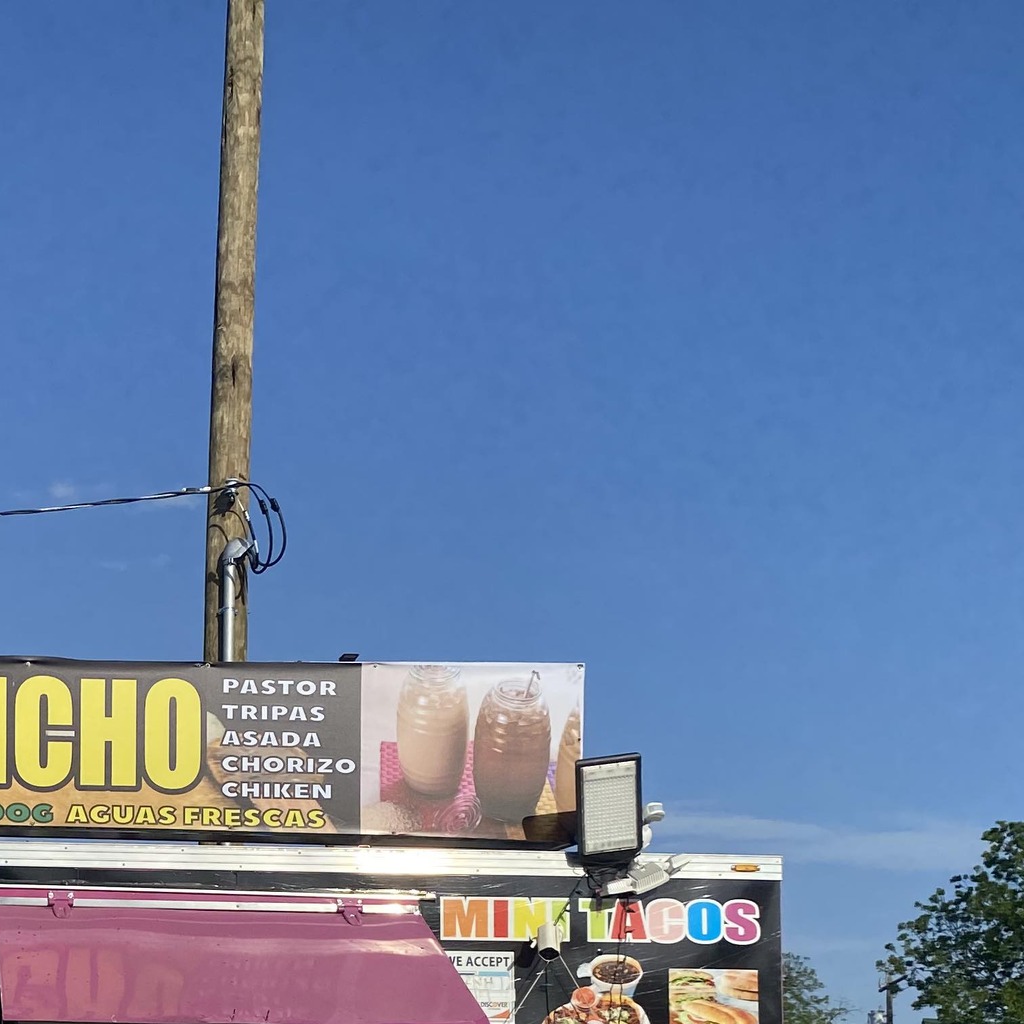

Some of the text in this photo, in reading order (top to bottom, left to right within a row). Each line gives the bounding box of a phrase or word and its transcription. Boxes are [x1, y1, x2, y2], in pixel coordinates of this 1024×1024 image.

[221, 677, 337, 697] PASTOR
[221, 704, 326, 722] TRIPAS
[221, 729, 321, 748] ASADA
[221, 755, 356, 774] CHORIZO
[221, 781, 333, 800] CHIKEN
[67, 804, 178, 827] AGUAS
[183, 806, 326, 830] FRESCAS
[441, 897, 761, 945] MINI TACOS
[466, 956, 509, 967] ACCEPT
